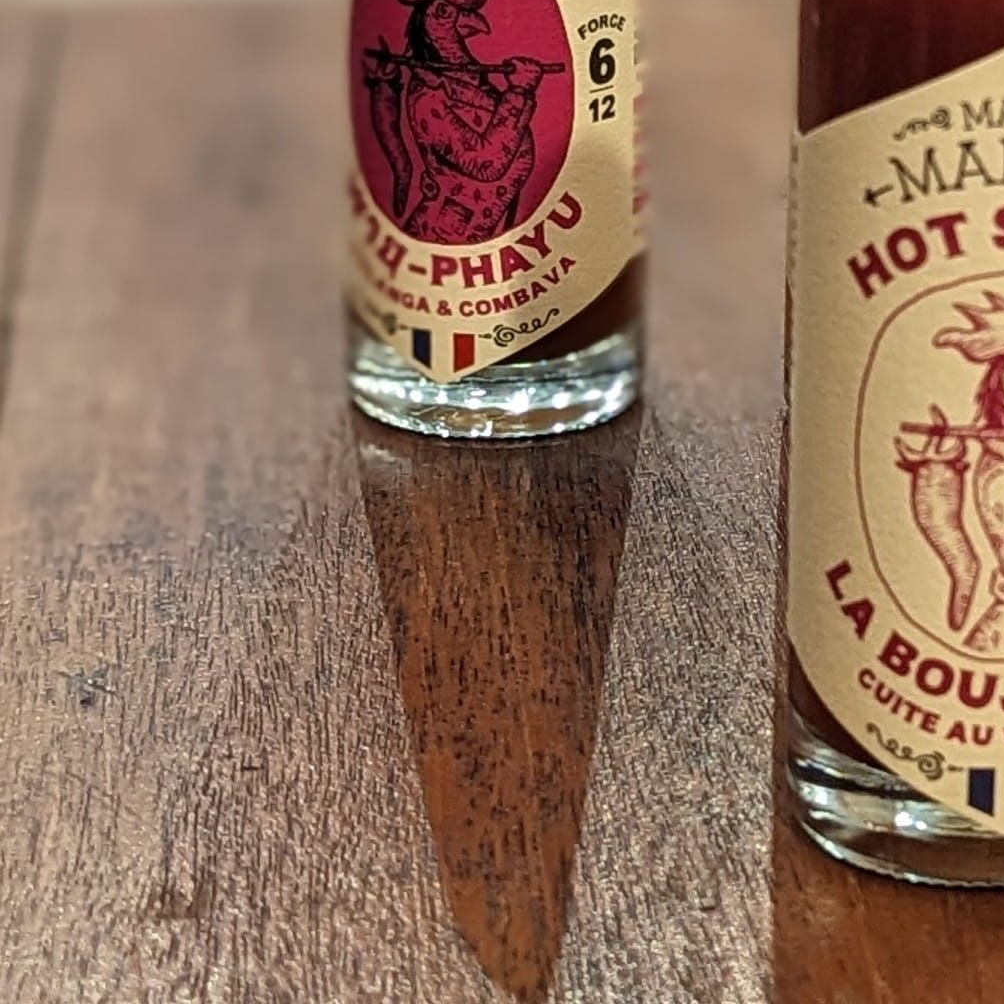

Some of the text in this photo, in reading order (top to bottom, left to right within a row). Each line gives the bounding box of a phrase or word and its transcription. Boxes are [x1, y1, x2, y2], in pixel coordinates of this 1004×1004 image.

[577, 14, 626, 41] FORCE
[588, 38, 616, 85] 6
[588, 95, 616, 123] 12
[436, 299, 453, 317] &
[459, 255, 577, 318] COMBAVA
[846, 211, 970, 299] HOT
[825, 559, 876, 641] LA
[857, 667, 940, 735] CUITE
[946, 720, 995, 747] AU
